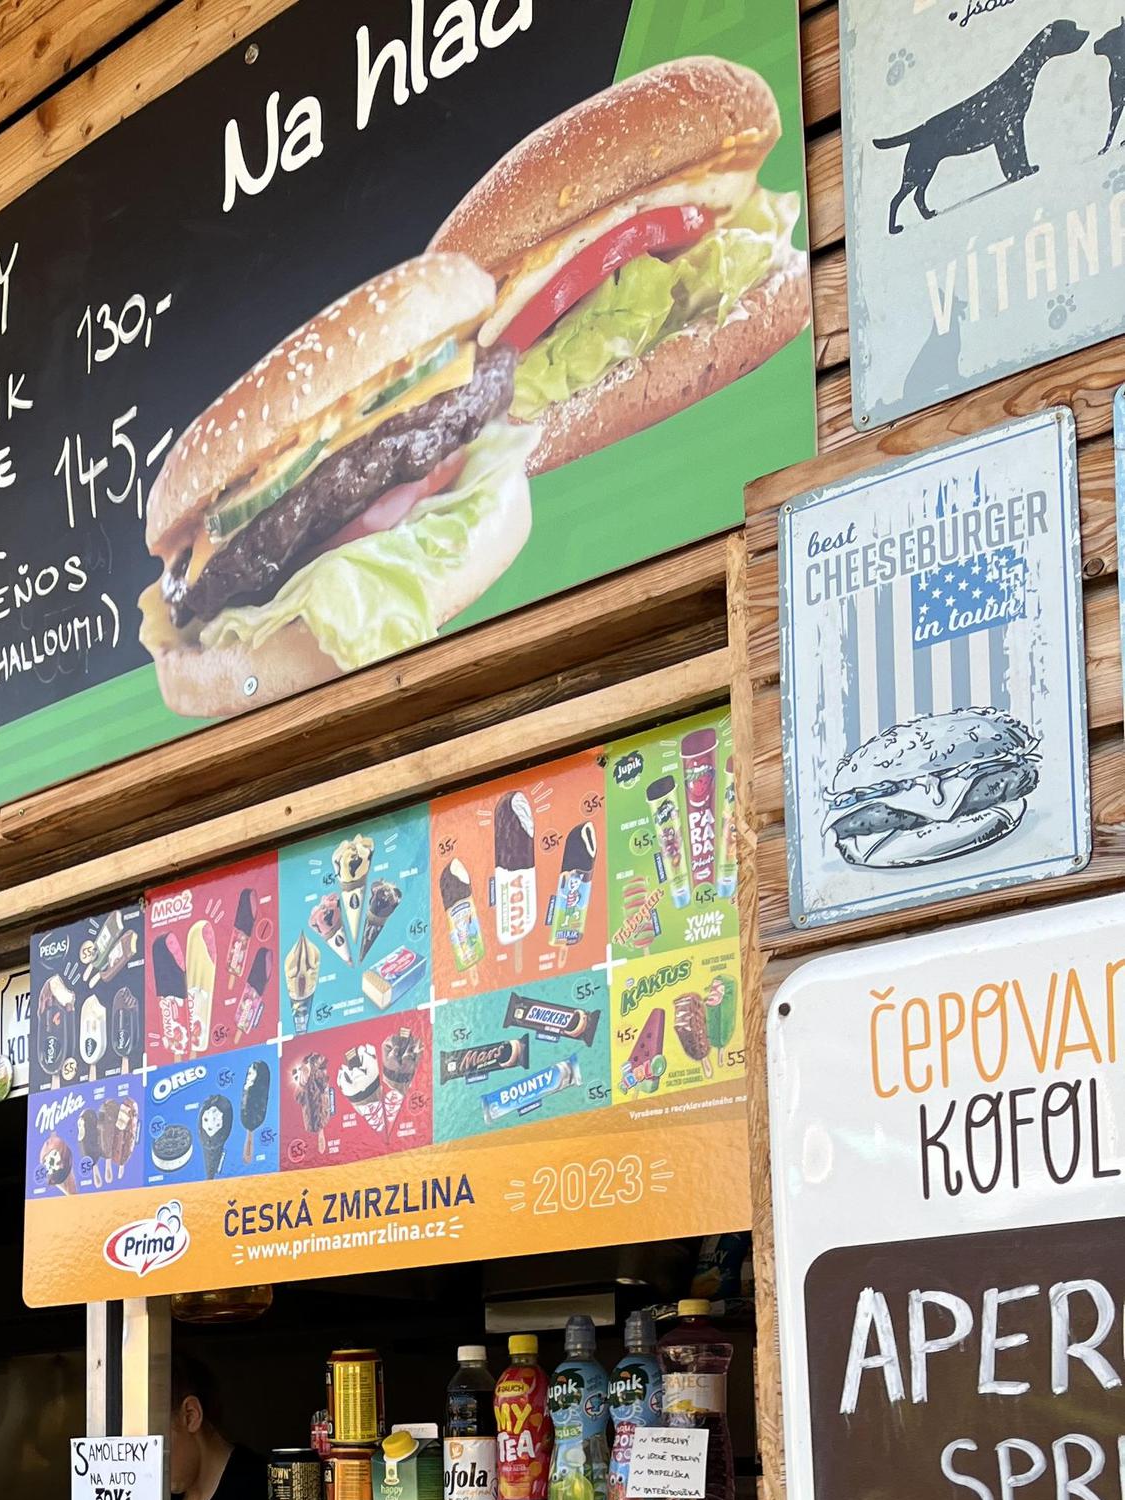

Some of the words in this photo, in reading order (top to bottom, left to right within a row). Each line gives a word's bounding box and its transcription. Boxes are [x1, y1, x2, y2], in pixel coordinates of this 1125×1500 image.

[222, 91, 323, 212] Na
[805, 490, 1048, 607] CHEESEBURGER
[806, 522, 858, 558] best
[914, 611, 943, 642] in
[947, 597, 1022, 631] town
[617, 757, 641, 778] Jupik
[511, 875, 524, 937] KUBA
[687, 913, 716, 928] YUM
[693, 924, 722, 938] YUM
[40, 940, 67, 958] PEGAS
[620, 960, 692, 1016] KAKTUS
[528, 1007, 571, 1026] SNICKERS
[460, 1045, 504, 1071] Mars
[153, 1066, 207, 1100] OREO
[500, 1069, 553, 1104] BOUNTY
[35, 1092, 85, 1134] Milka
[223, 1192, 312, 1237] ČESKÁ
[323, 1173, 476, 1223] ZMRZLINA
[532, 1155, 644, 1215] 2023
[124, 1232, 175, 1258] Prima
[246, 1221, 446, 1262] www.primazmrzlina.cz
[839, 1278, 1125, 1414] APER
[494, 1403, 532, 1434] MY
[75, 1441, 149, 1477] SAMOLEPKY
[90, 1473, 104, 1486] NA
[109, 1471, 137, 1486] AUTO
[380, 1485, 403, 1499] happy
